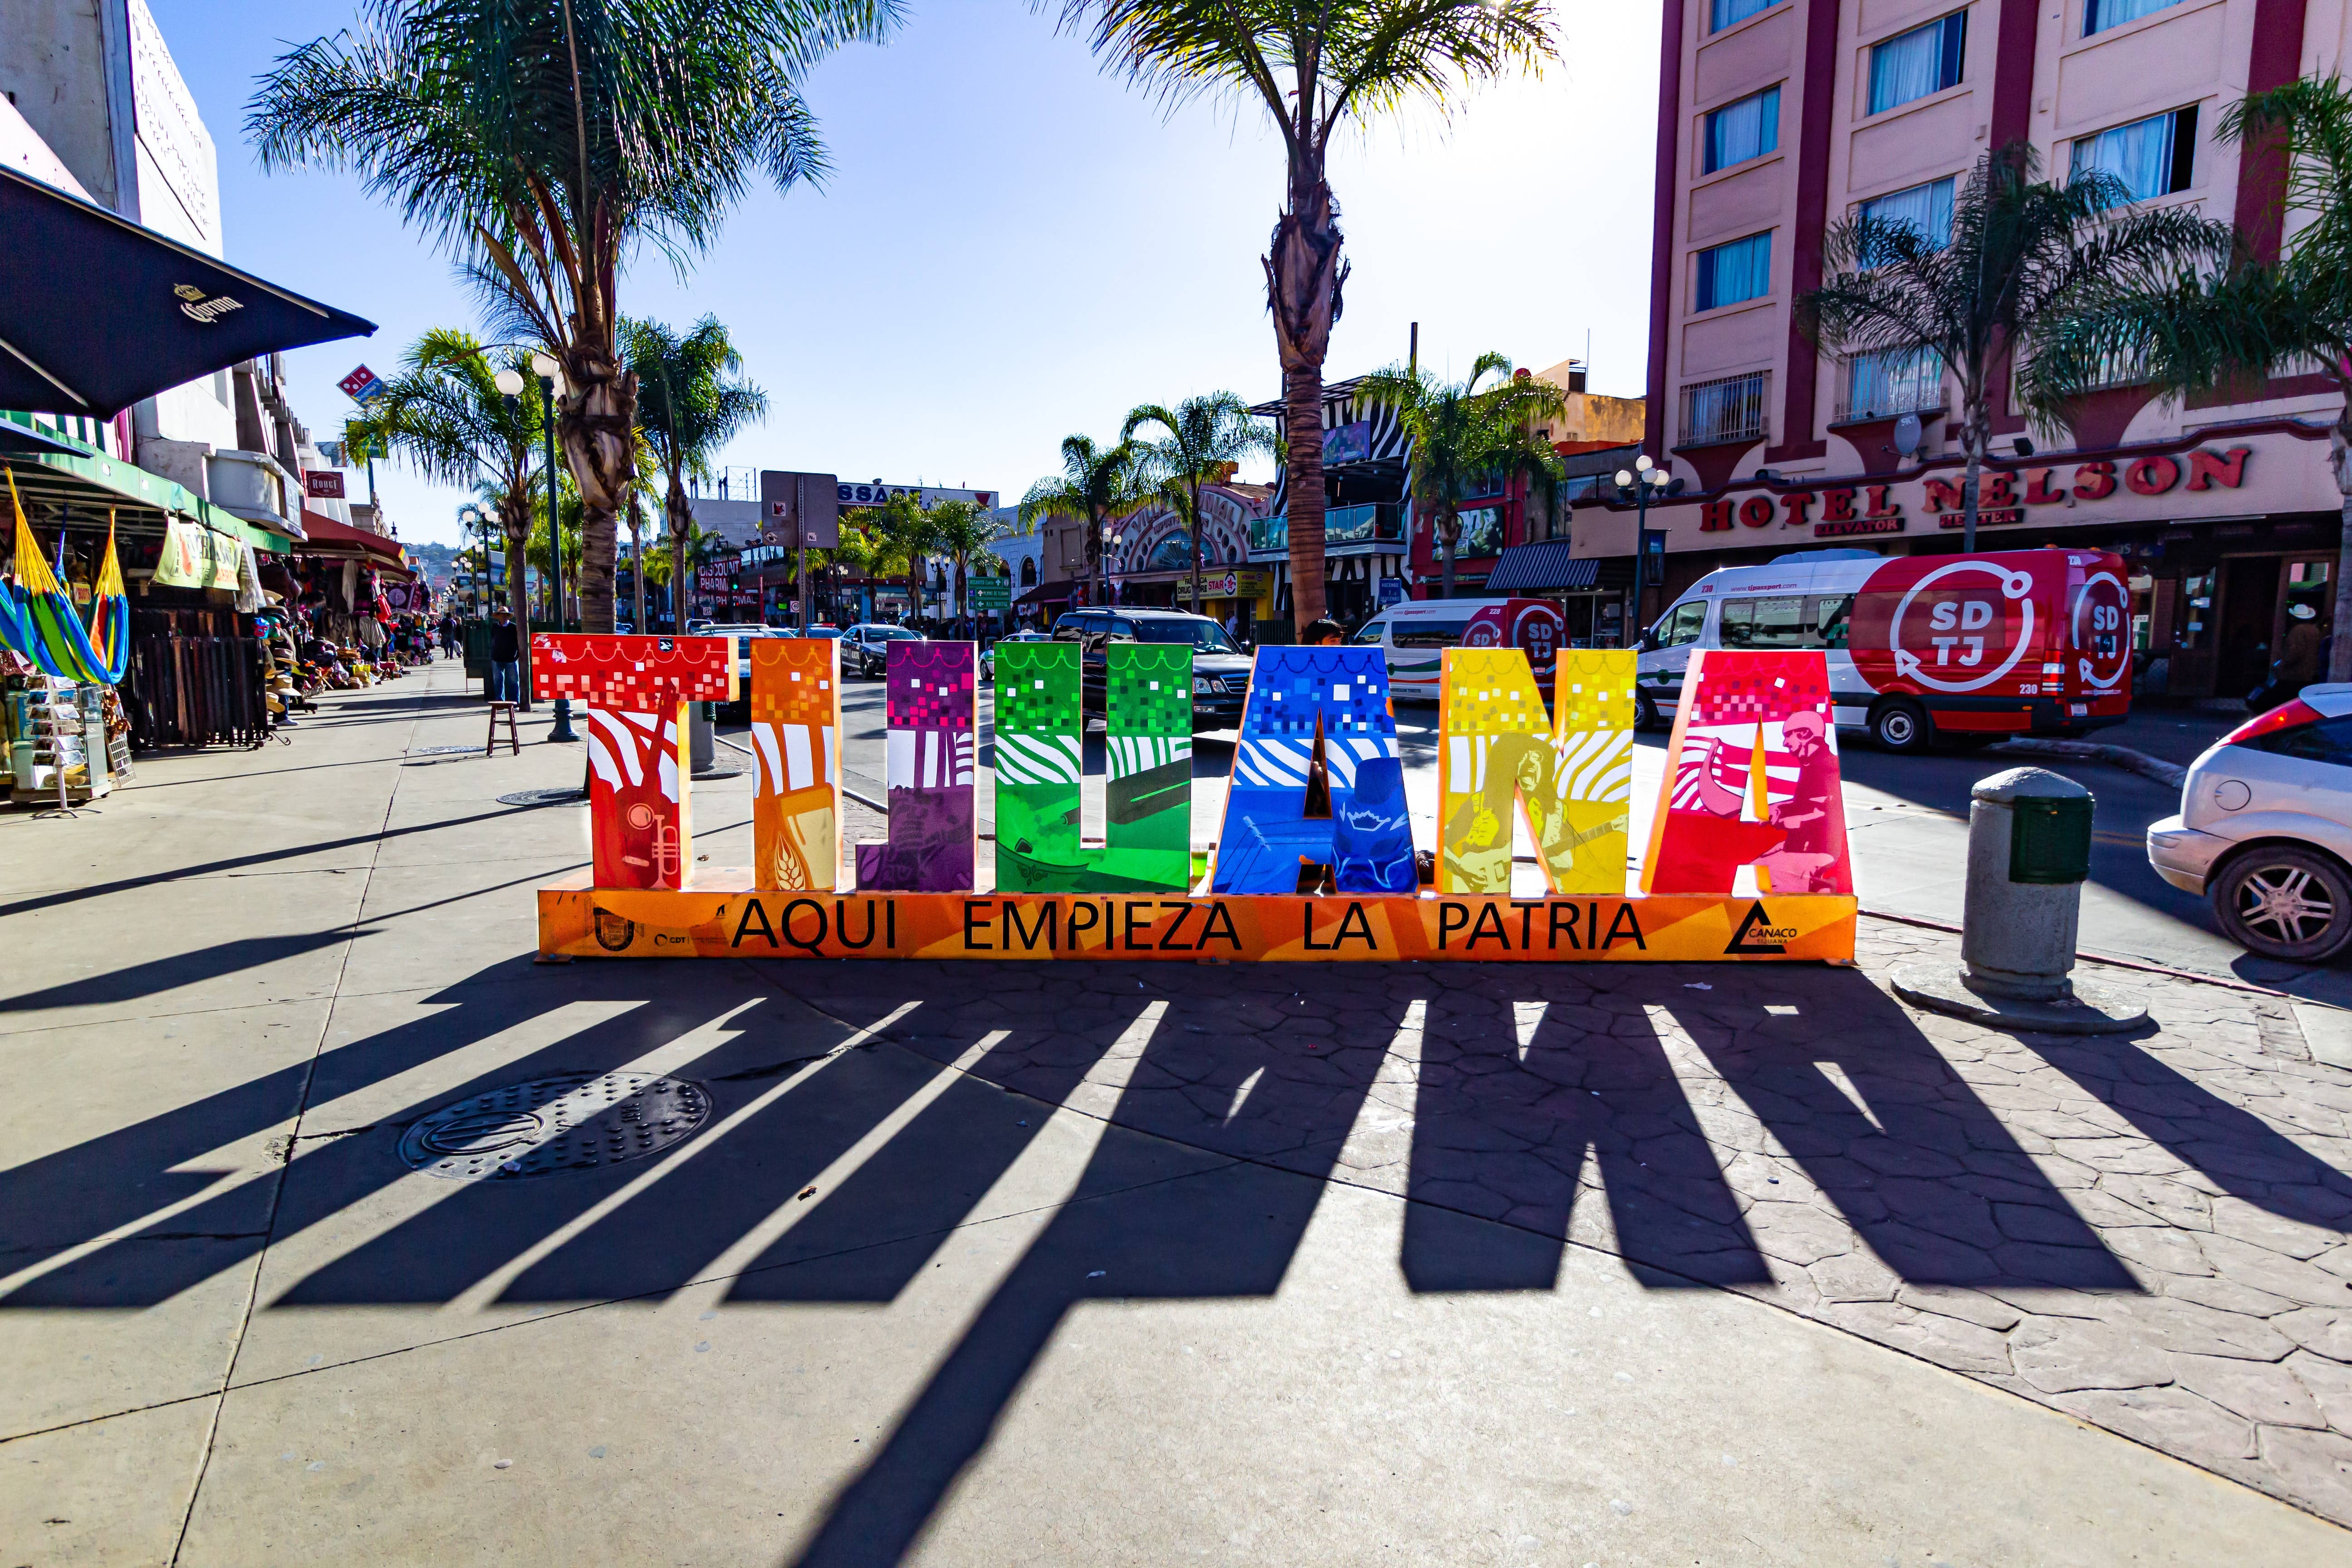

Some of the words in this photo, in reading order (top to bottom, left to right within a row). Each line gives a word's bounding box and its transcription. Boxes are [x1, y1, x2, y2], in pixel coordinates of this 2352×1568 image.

[181, 297, 244, 323] Corona
[313, 479, 338, 490] ROUGE
[1699, 485, 1900, 532] HOTEL
[1922, 448, 2251, 513] NELSON
[1816, 518, 1899, 535] ELEVATOR
[1940, 509, 2017, 527] HETER
[1208, 580, 1224, 590] STAR
[1701, 585, 1713, 593] 230
[1731, 583, 1797, 592] www.tjpassport.com
[1929, 600, 1993, 631] SD
[2093, 605, 2119, 630] SD
[1472, 633, 1490, 646] SD
[1528, 623, 1552, 640] SD
[1530, 642, 1551, 658] TJ
[1931, 636, 1984, 666] TJ
[2019, 684, 2038, 695] 230
[531, 632, 1860, 895] TIJUANA
[730, 898, 896, 956] AQUI
[964, 901, 1242, 951] EMPIEZA
[1304, 902, 1377, 951] LA
[1438, 902, 1647, 951] PATRIA
[1749, 928, 1797, 938] CANACO
